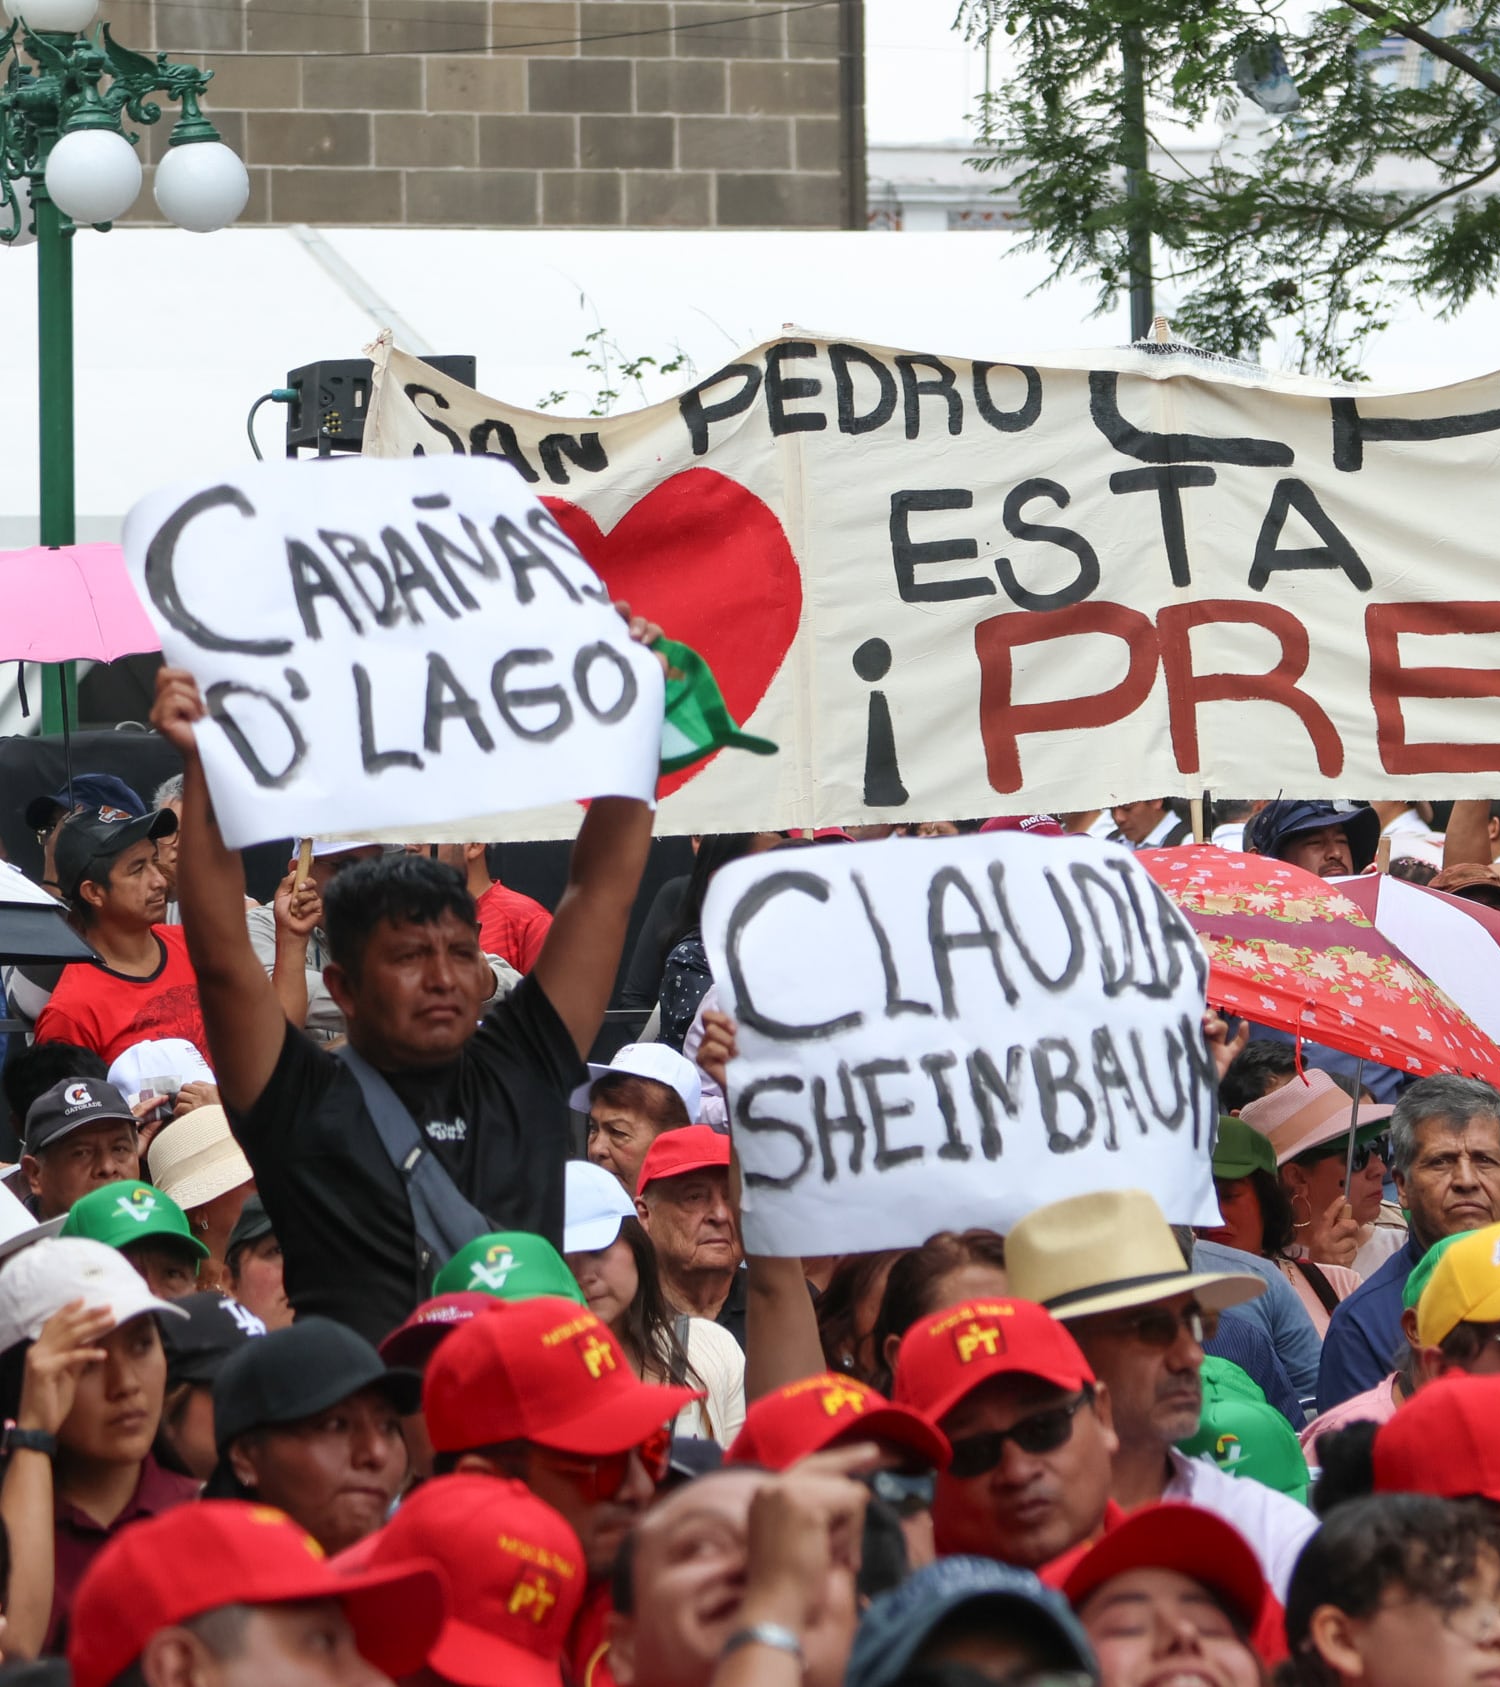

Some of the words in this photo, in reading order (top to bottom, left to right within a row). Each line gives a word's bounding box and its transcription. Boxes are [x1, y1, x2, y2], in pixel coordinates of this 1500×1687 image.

[404, 383, 608, 485] SAN
[680, 341, 1044, 456] PEDRO
[889, 465, 1373, 612] ESTA
[351, 640, 640, 775] LAGO
[725, 859, 1208, 1040] CLAUDIA
[64, 1100, 103, 1116] GATORADE
[734, 1013, 1219, 1190] SHEINBAUM
[218, 1299, 266, 1336] LA
[957, 1323, 1000, 1362] PT
[508, 1577, 556, 1624] PT
